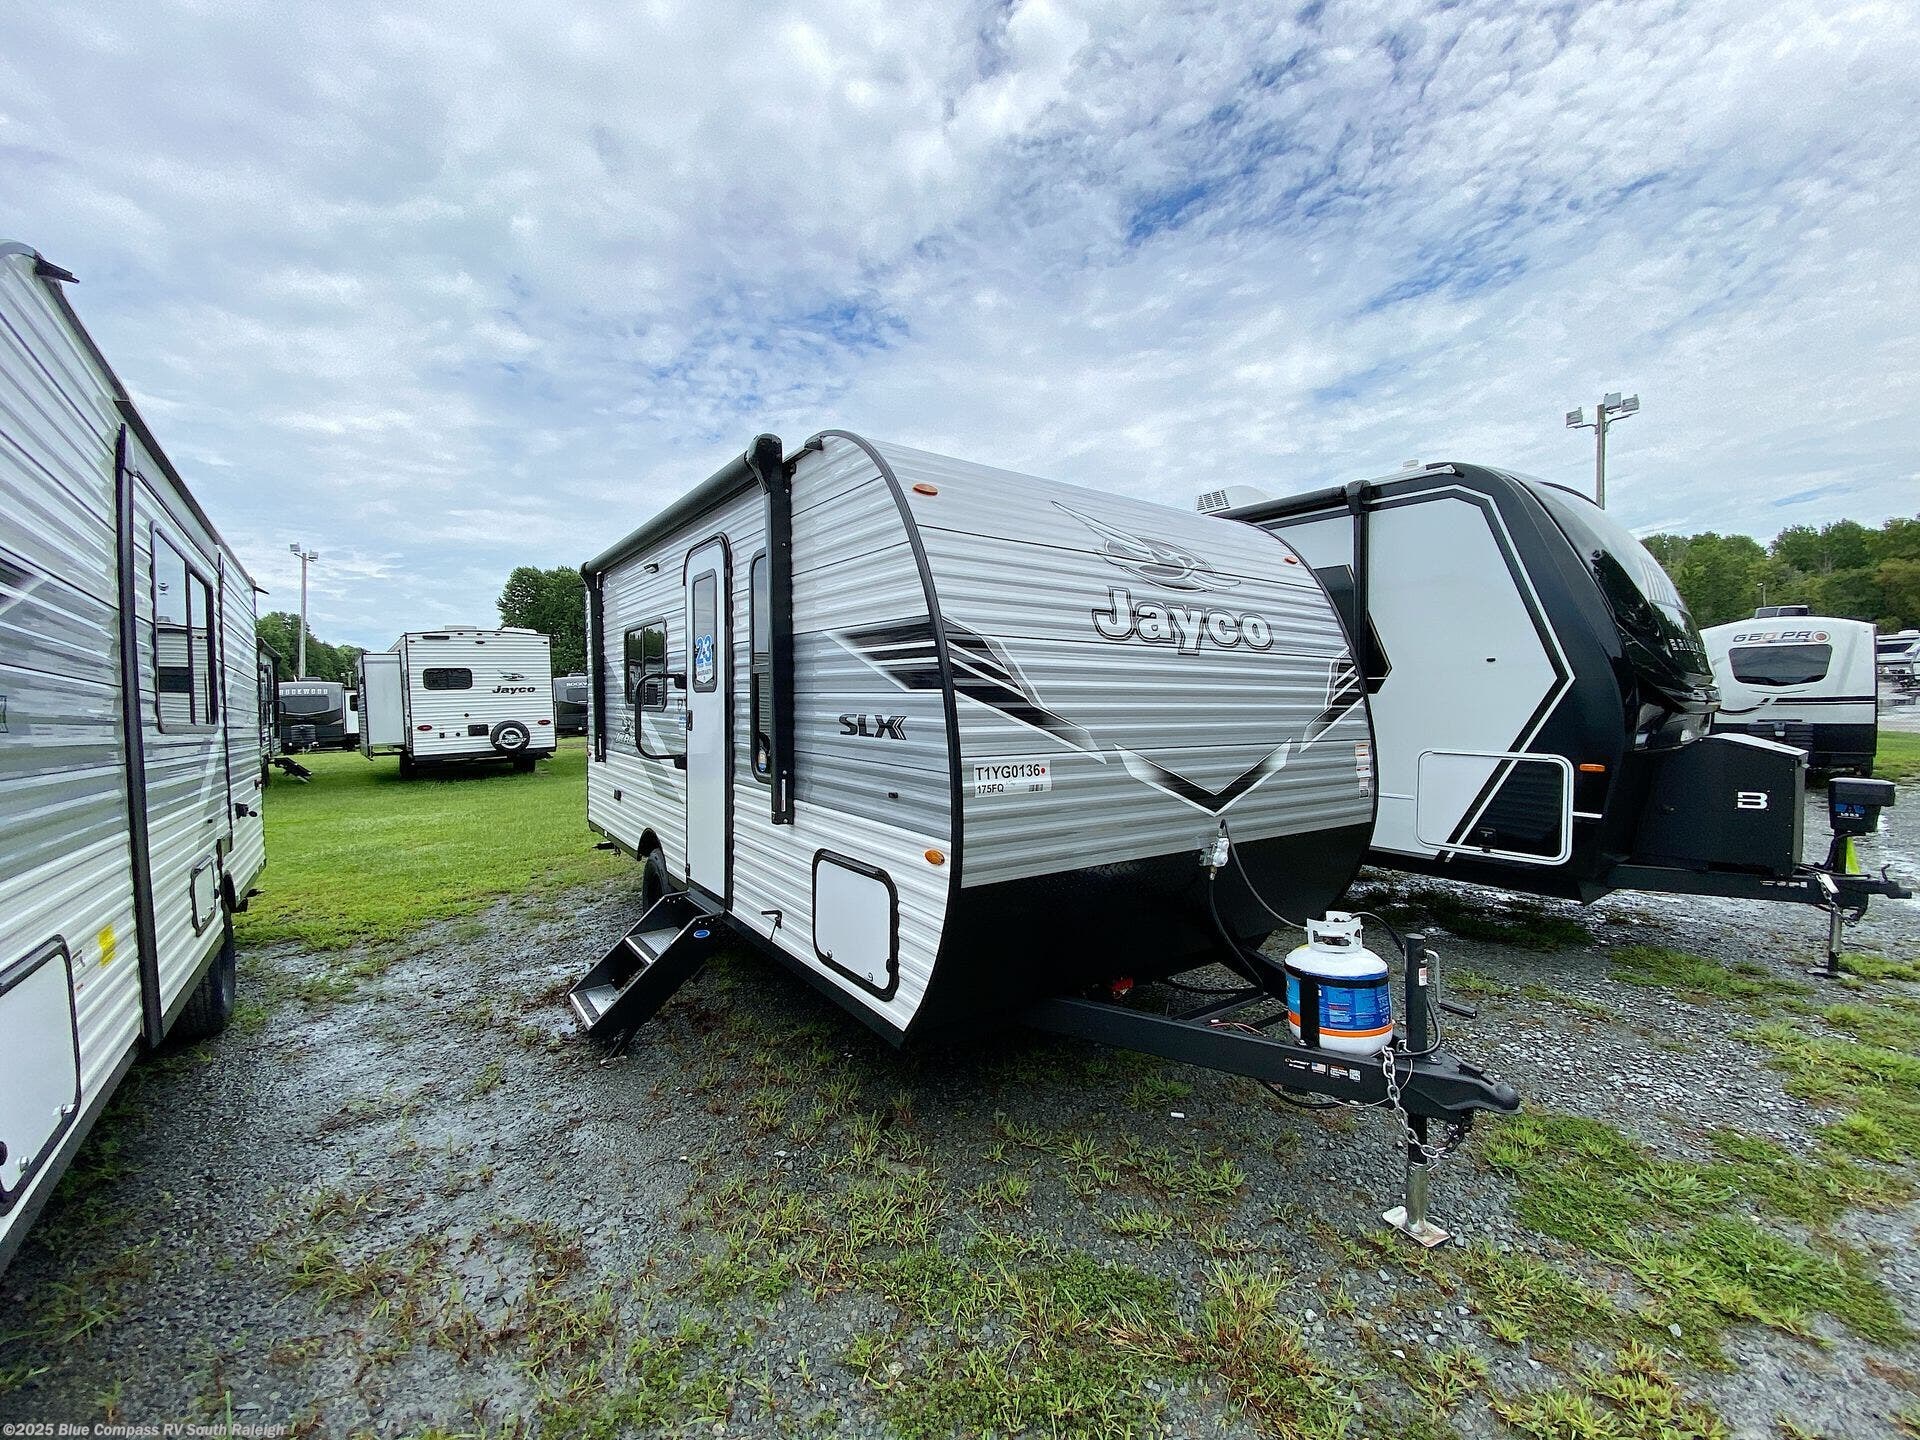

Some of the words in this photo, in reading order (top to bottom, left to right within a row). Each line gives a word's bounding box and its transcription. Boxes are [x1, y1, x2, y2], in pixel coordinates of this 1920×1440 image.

[1091, 585, 1274, 656] Jayco
[1732, 632, 1777, 643] GEO
[279, 688, 328, 696] ROCKWOOD
[491, 686, 536, 695] Jayco
[838, 713, 907, 740] SLX
[975, 763, 1040, 780] T1YG0136
[976, 783, 1004, 794] 175FQ
